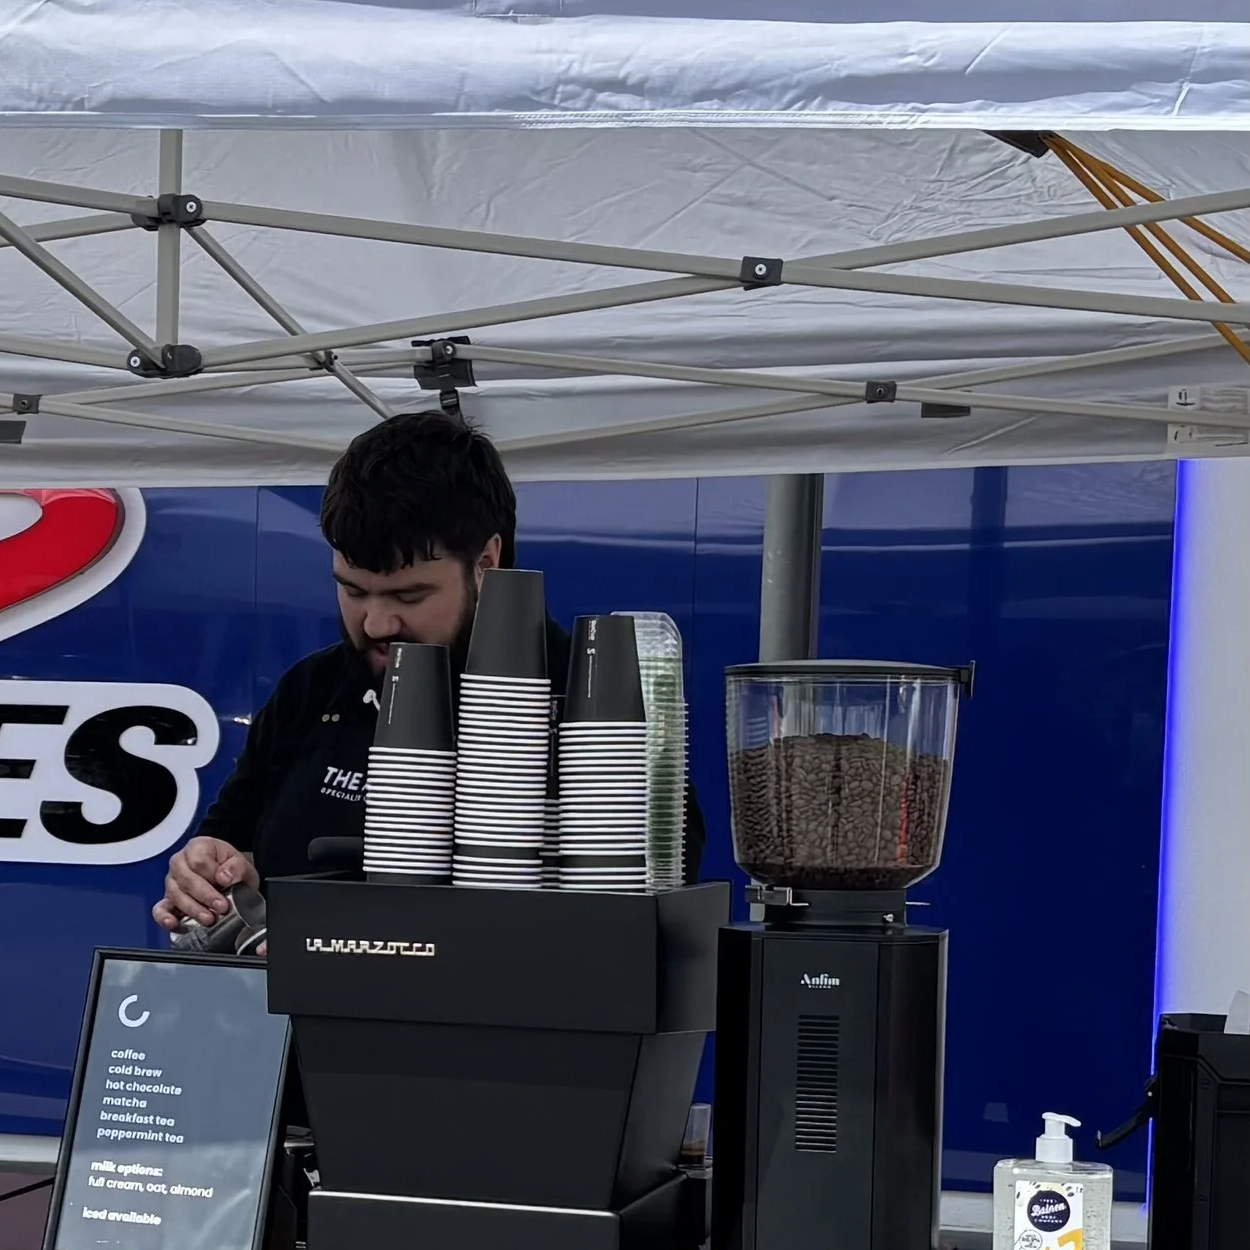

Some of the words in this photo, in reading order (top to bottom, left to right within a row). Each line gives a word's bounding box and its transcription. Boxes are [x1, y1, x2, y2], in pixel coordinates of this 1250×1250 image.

[323, 766, 363, 791] THE
[111, 1049, 146, 1061] coffee
[108, 1065, 133, 1076] cold
[134, 1066, 163, 1078] brew
[105, 1079, 125, 1090] hot
[125, 1081, 182, 1095] chocolate
[102, 1096, 147, 1108] matcha
[100, 1110, 154, 1125] breakfast
[155, 1115, 175, 1127] tea
[97, 1127, 164, 1141] peppermint
[164, 1132, 184, 1144] tea
[90, 1160, 116, 1173] milk
[88, 1175, 105, 1187] full
[169, 1184, 214, 1198] almond
[107, 1209, 162, 1226] available
